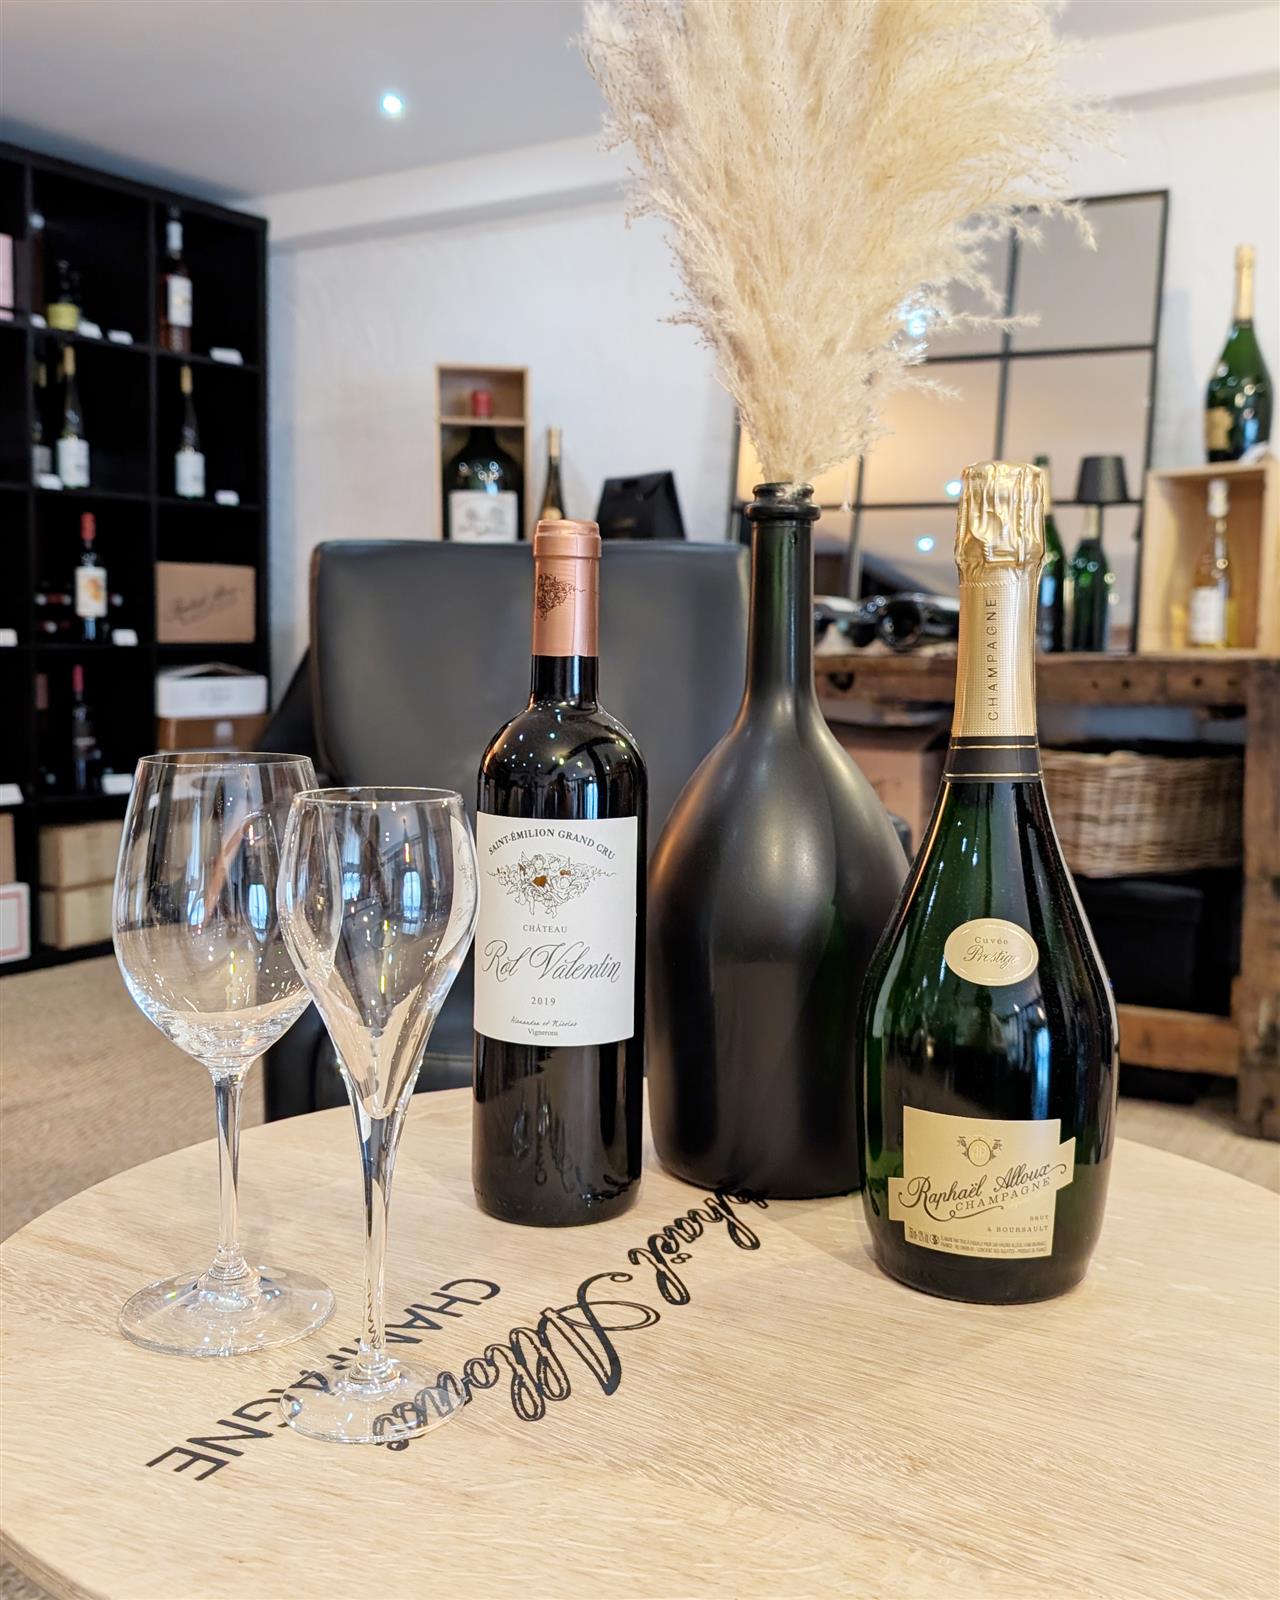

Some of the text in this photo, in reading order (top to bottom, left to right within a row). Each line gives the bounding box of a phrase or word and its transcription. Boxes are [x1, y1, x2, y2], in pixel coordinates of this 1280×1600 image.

[985, 599, 999, 721] CHAMPAGNE
[488, 828, 616, 860] SAINT-ÉMILION GRAND CRU
[522, 923, 568, 934] CHÂTEAU
[974, 936, 1010, 945] Cuvée
[482, 939, 622, 984] Rol Valentin
[963, 944, 1018, 970] Prestige
[531, 996, 556, 1006] 2019
[898, 1163, 1067, 1222] Raphaël Alloux
[955, 1177, 1051, 1212] CHAMPAGNE
[996, 1224, 1049, 1233] BOURSAULT
